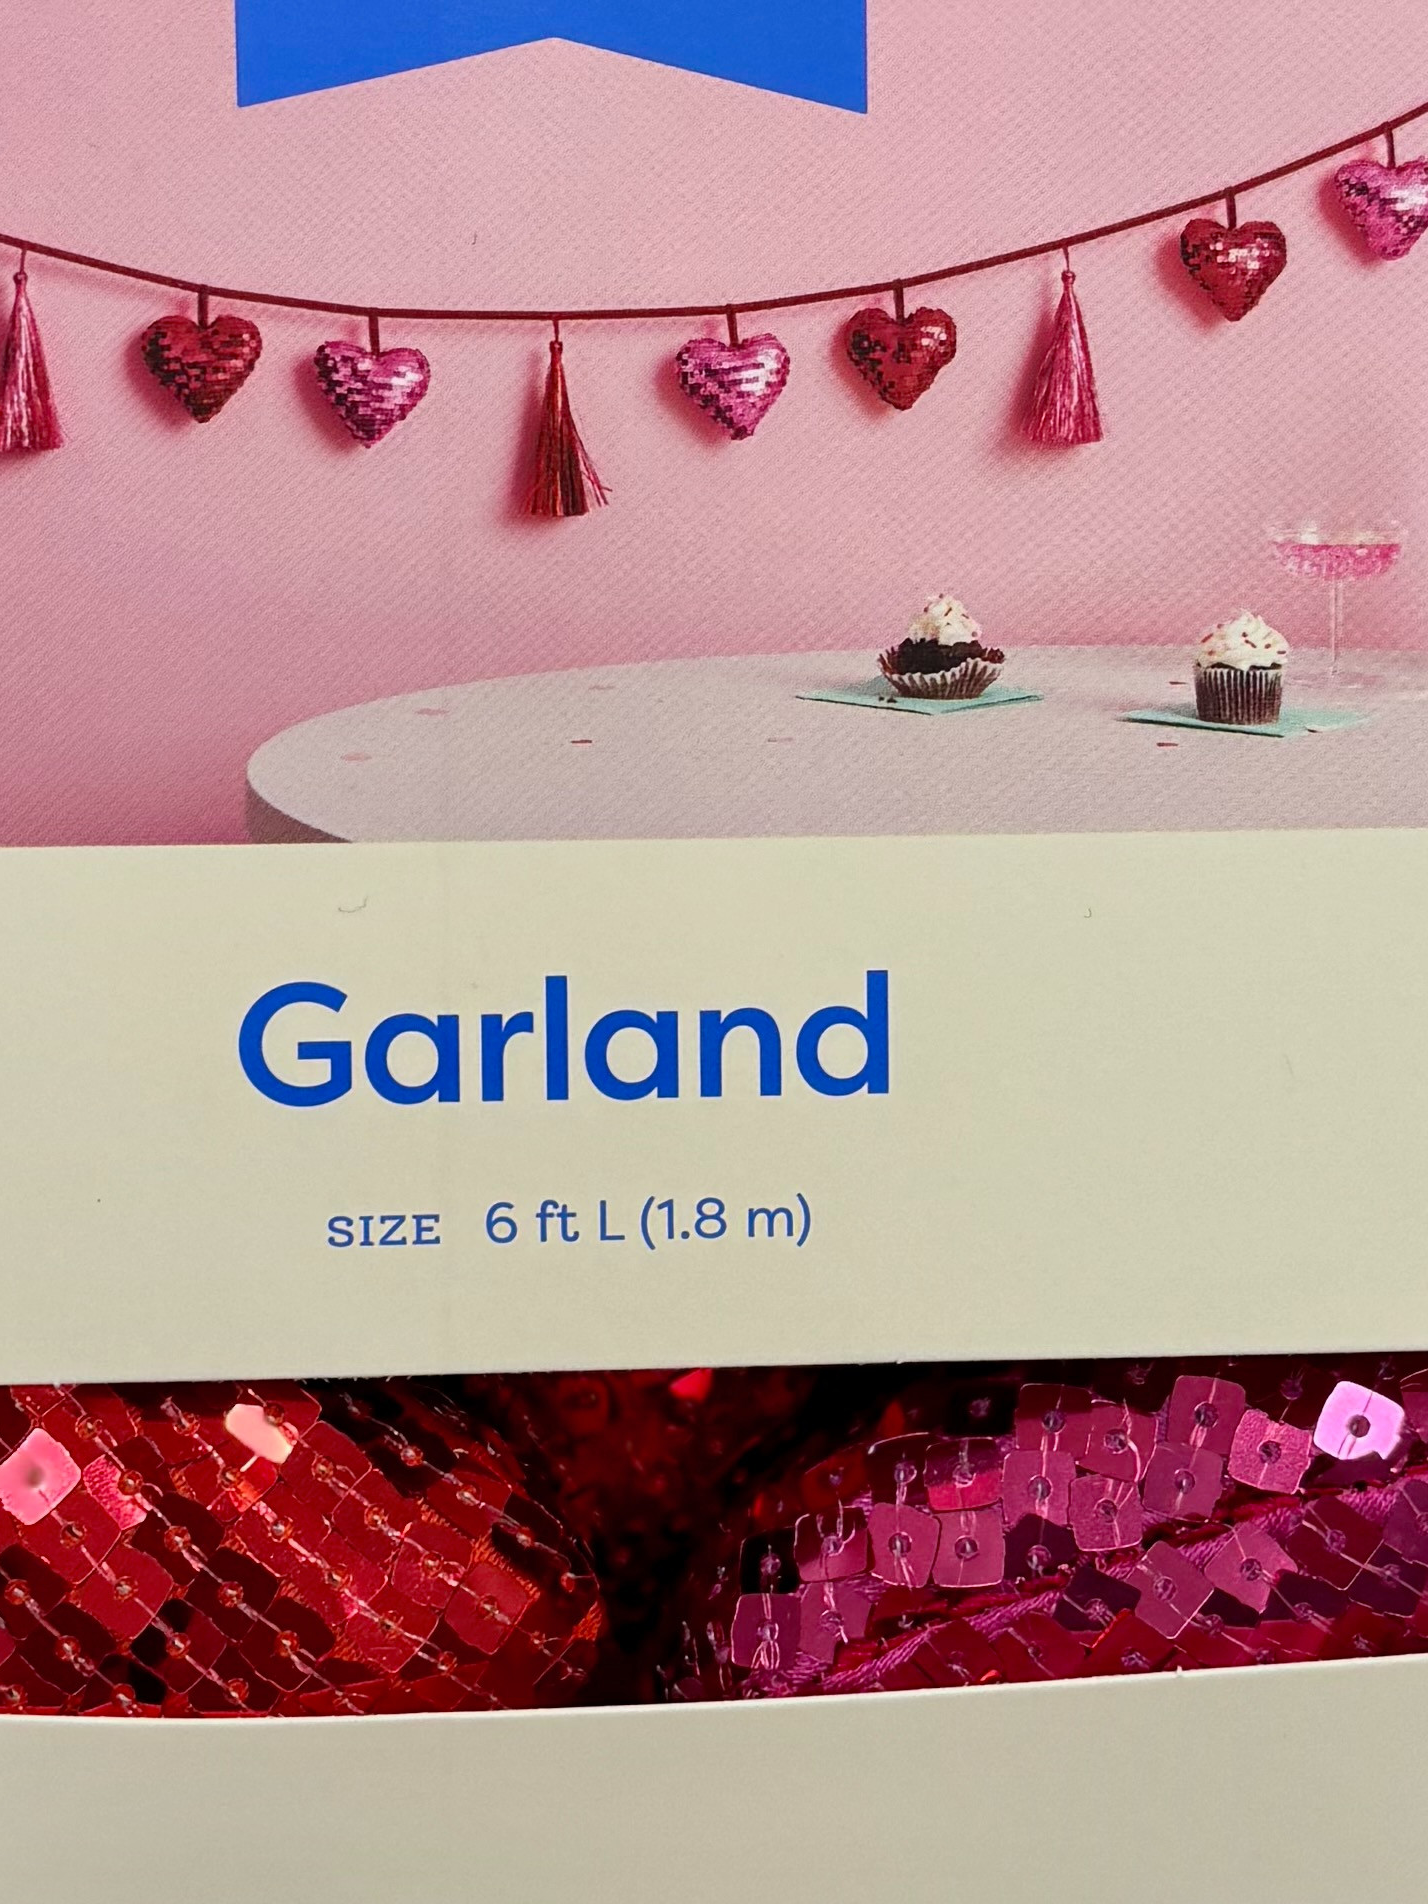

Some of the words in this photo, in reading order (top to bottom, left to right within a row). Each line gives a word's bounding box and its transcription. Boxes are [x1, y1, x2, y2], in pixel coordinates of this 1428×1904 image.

[238, 970, 889, 1108] Garland
[326, 1213, 441, 1248] SIZE
[484, 1202, 518, 1245] 6
[535, 1200, 579, 1244] ft
[598, 1200, 625, 1242] L
[639, 1196, 726, 1251] (1.8
[746, 1194, 811, 1248] m)
